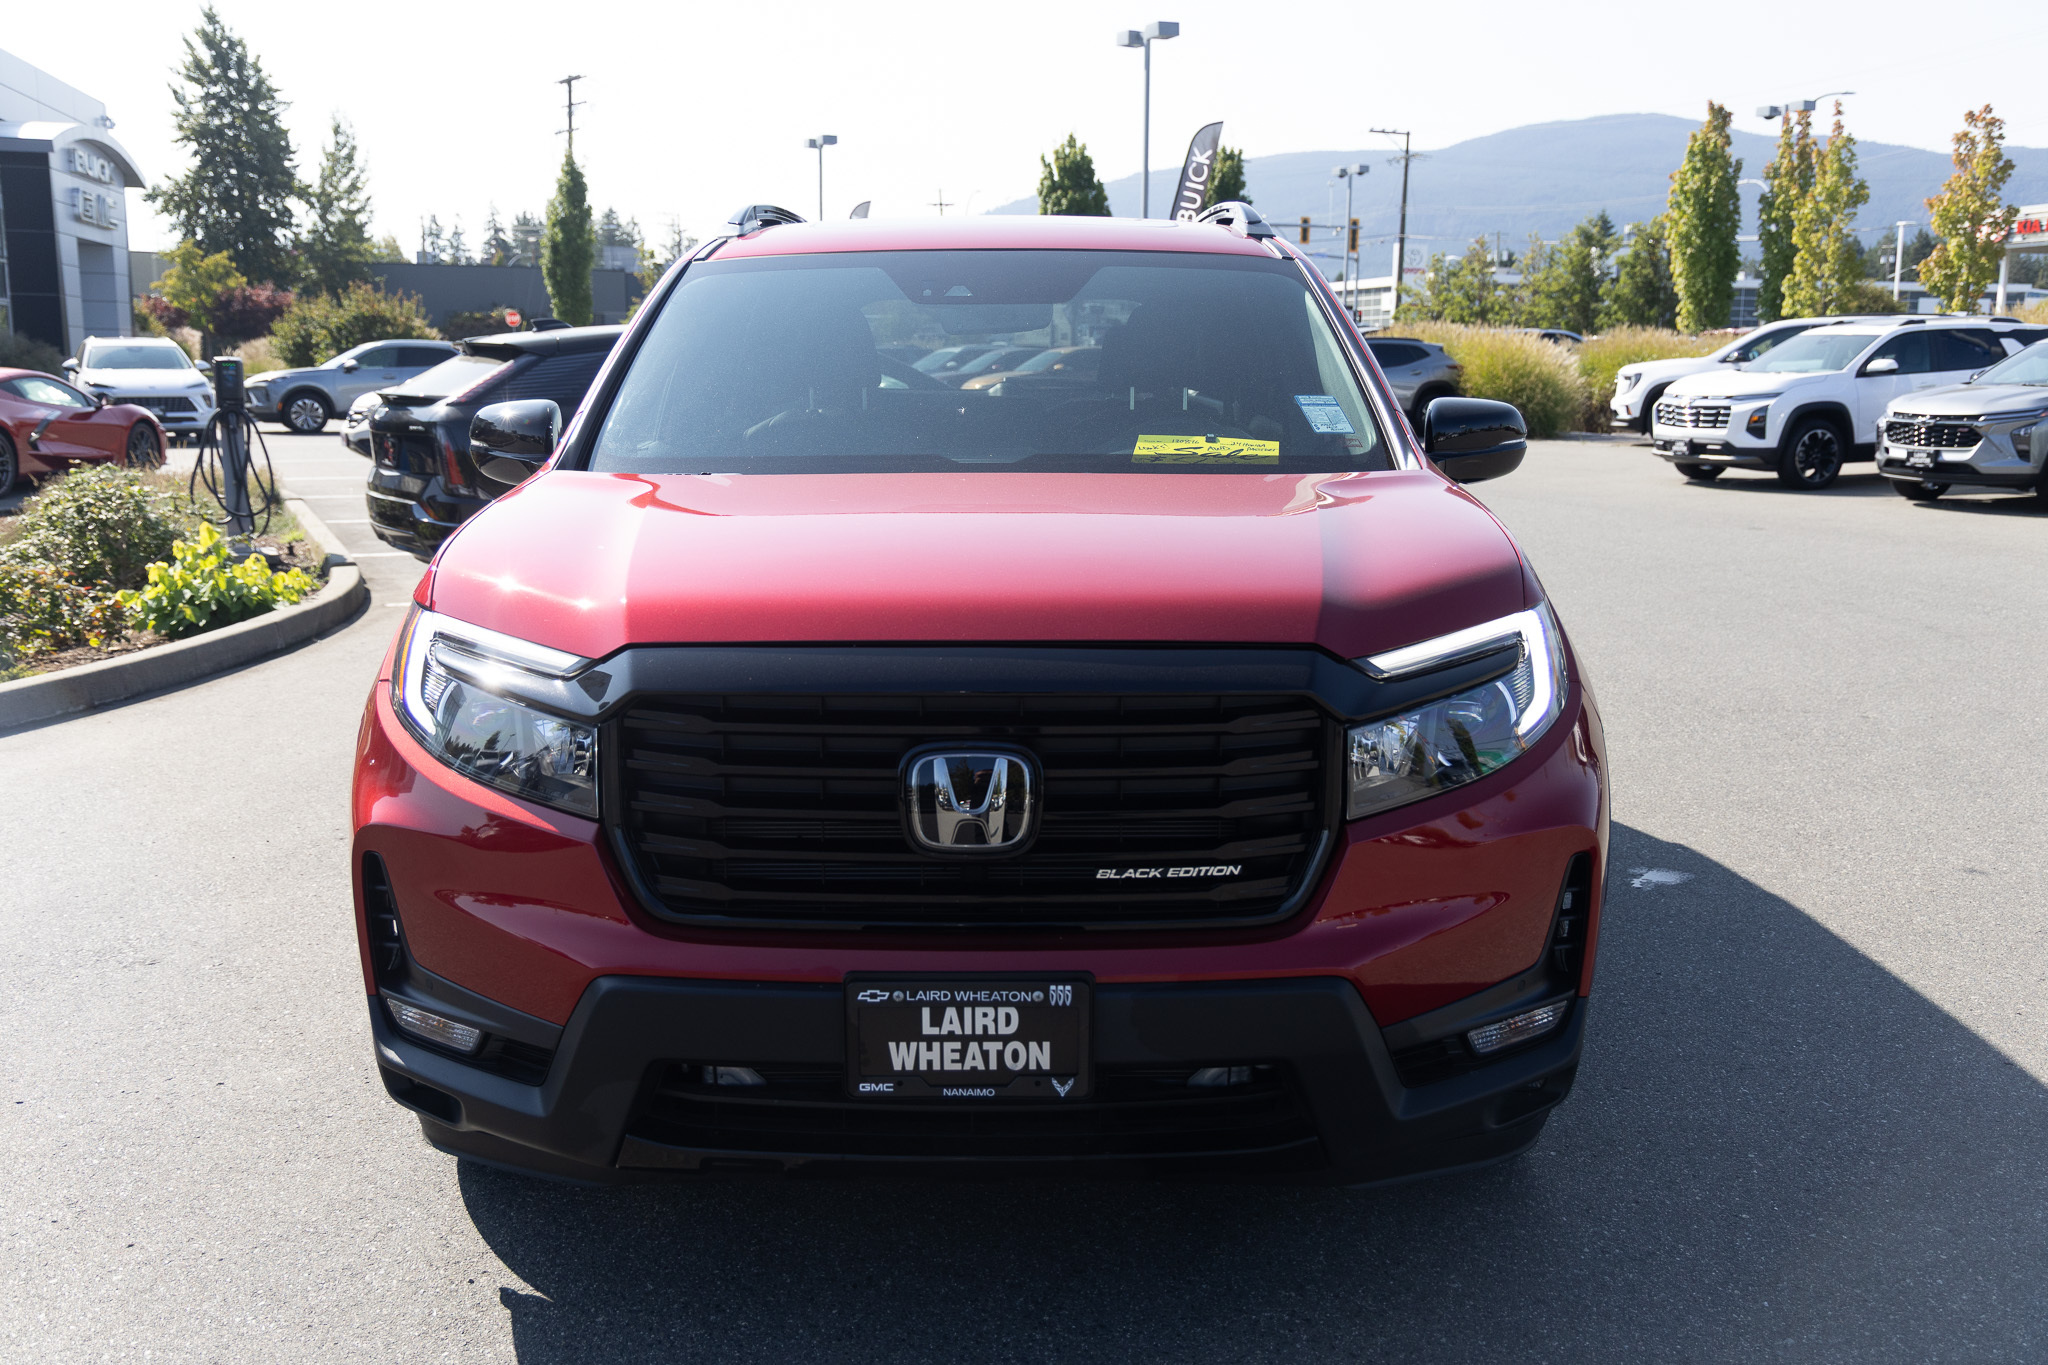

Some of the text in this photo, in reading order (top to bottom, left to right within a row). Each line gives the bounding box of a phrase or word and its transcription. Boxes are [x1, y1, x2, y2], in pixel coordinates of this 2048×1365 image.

[1175, 146, 1214, 223] BUICK
[2016, 218, 2041, 235] KIA
[1096, 864, 1242, 879] BLACK EDITION
[906, 990, 1032, 1002] LAIRD WHEATON
[921, 1006, 1019, 1035] LAIRD
[888, 1040, 1051, 1071] WHEATON
[858, 1082, 894, 1092] GMC
[943, 1088, 995, 1097] NANAIMO
